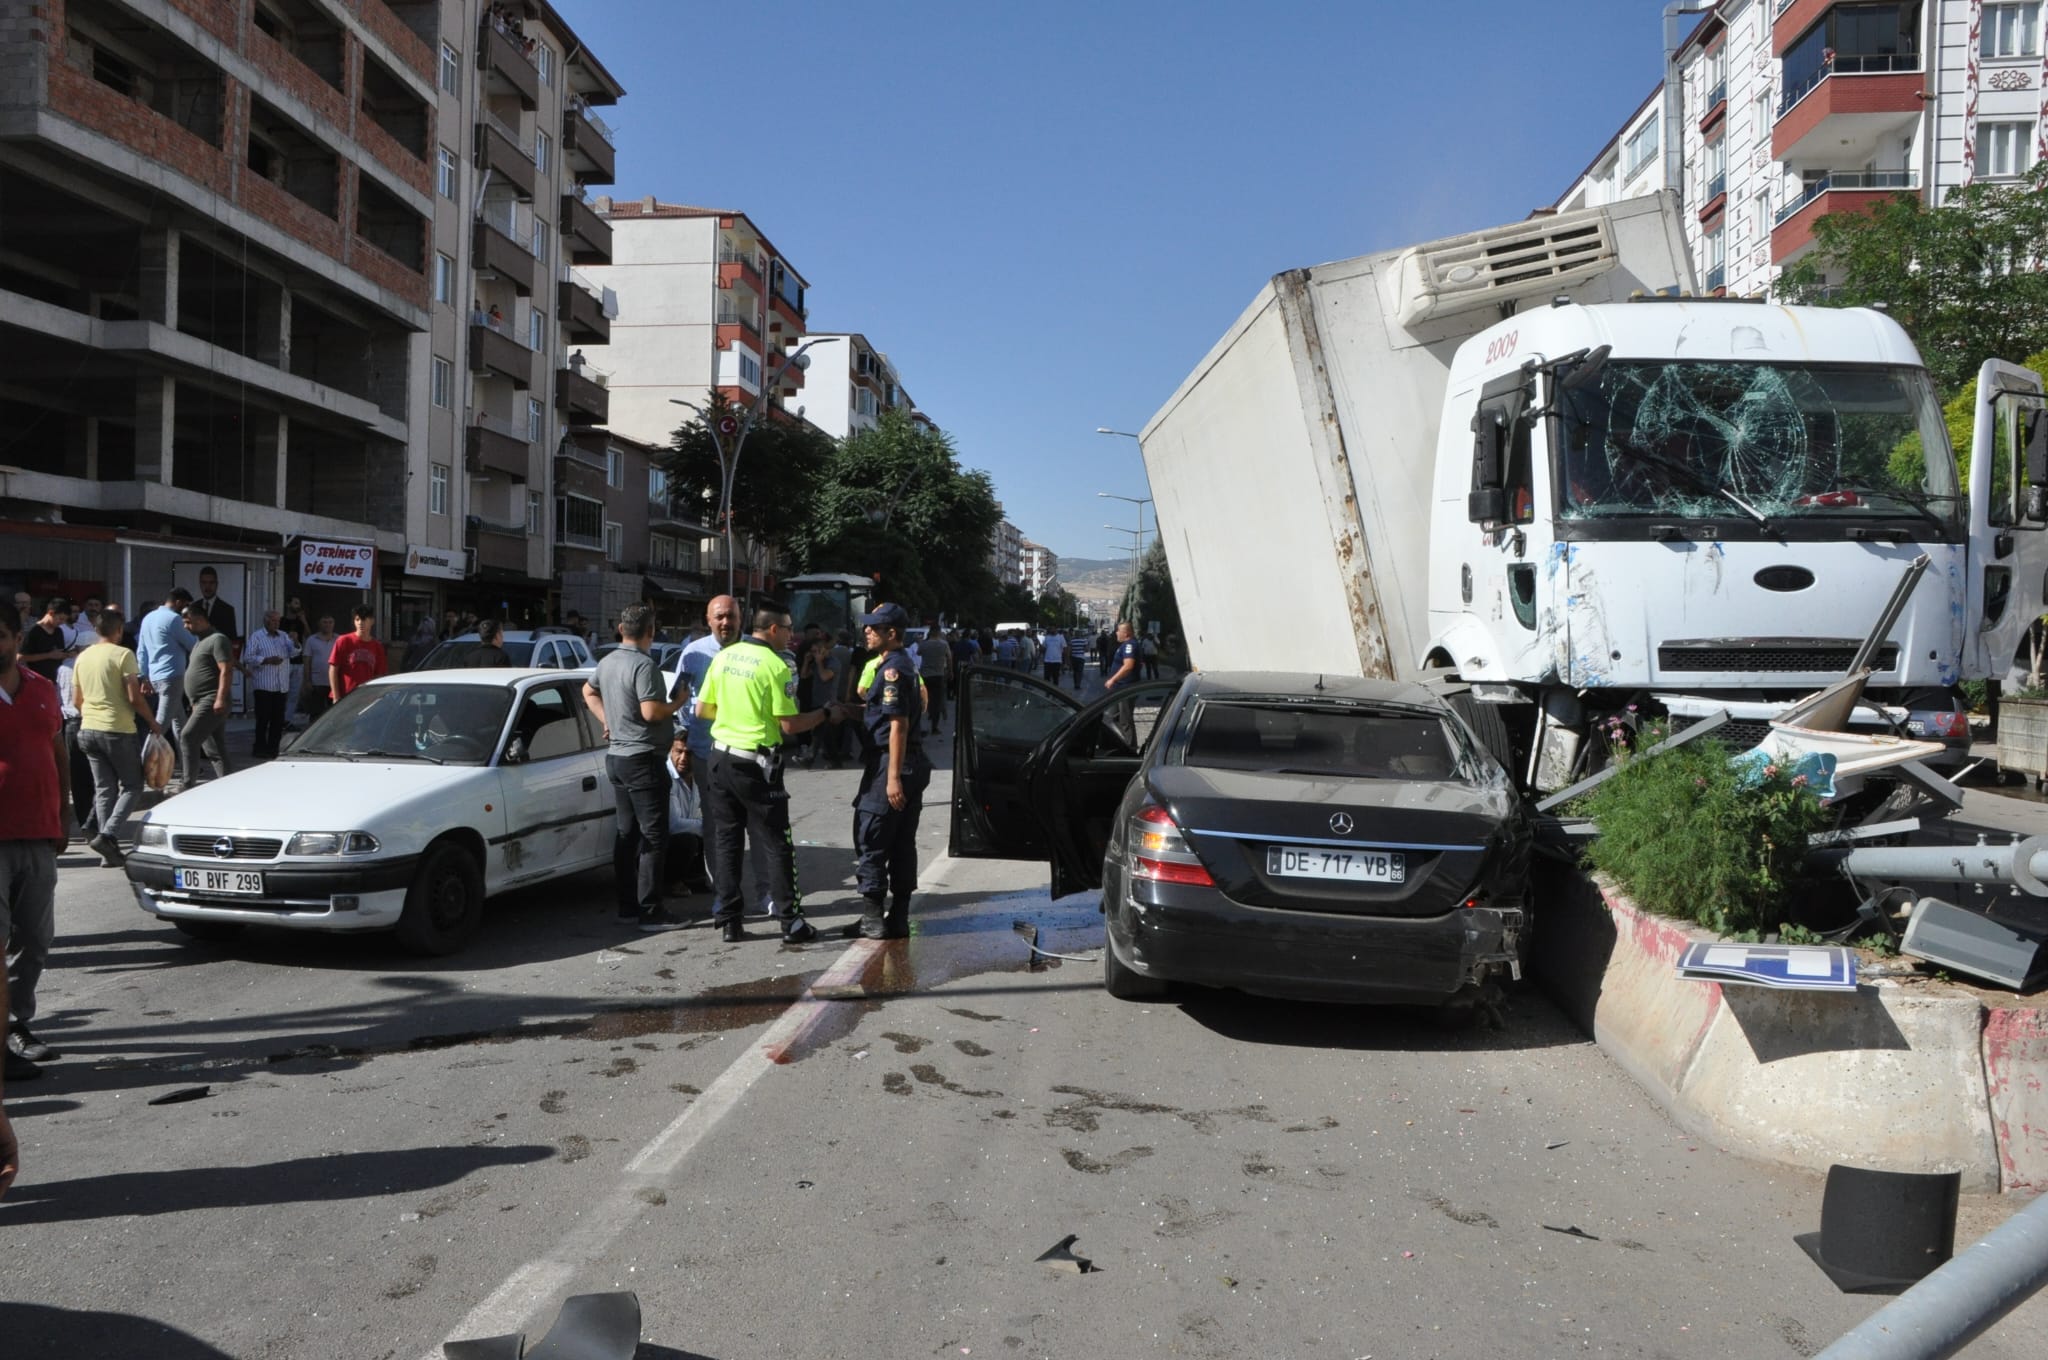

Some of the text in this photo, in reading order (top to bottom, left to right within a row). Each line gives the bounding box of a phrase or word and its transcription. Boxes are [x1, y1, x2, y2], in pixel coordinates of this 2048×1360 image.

[1485, 329, 1519, 366] 2009
[317, 545, 357, 560] SERİNCE
[419, 554, 449, 568] warmhaus
[304, 561, 364, 578] ÇİĞ KÖFTE
[184, 870, 261, 891] 06 BVF 299
